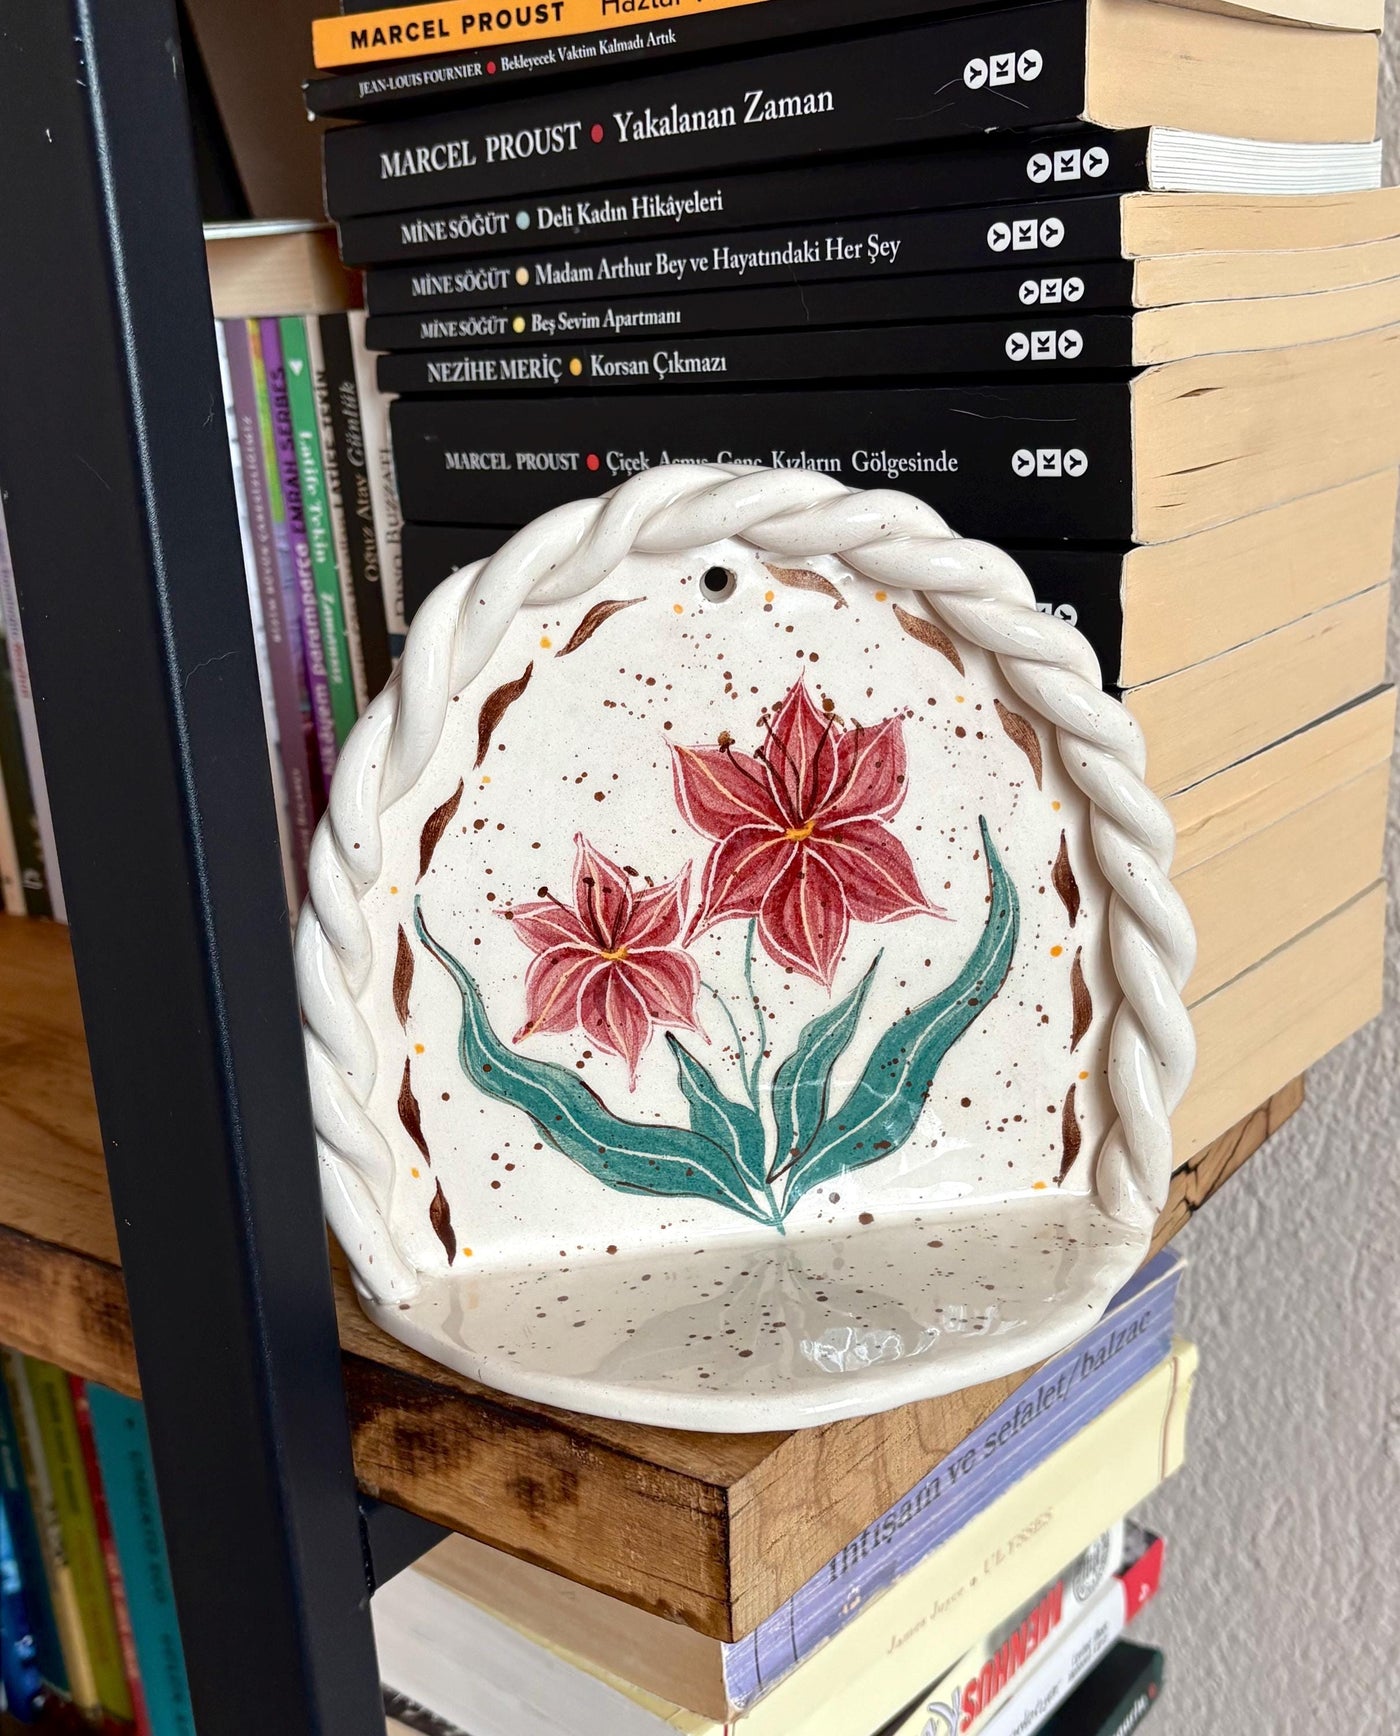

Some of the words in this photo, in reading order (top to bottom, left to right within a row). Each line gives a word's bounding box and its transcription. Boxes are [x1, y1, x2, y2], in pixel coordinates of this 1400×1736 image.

[351, 19, 450, 49] MARCEL
[462, 2, 565, 34] PROUST
[359, 72, 423, 98] JEAN-LOUIS
[424, 62, 482, 85] FOURNIER
[501, 51, 557, 73] Bekleyecek
[558, 44, 597, 62] Vaktim
[599, 34, 644, 55] Kalmadı
[646, 29, 677, 47] Artık
[380, 140, 476, 180] MARCEL
[486, 121, 582, 163] PROUST
[613, 103, 736, 142] Yakalanan
[743, 89, 834, 124] Zaman
[401, 217, 448, 244] MİNE
[449, 210, 510, 238] SÖĞÜT
[536, 204, 574, 230] Deli
[577, 200, 628, 225] Kadın
[631, 189, 723, 222] Hikâyeleri
[412, 270, 453, 296] MİNE
[454, 266, 511, 292] SÖĞÜT
[535, 260, 593, 286] Madam
[597, 256, 652, 280] Arthur
[655, 252, 687, 280] Bey
[690, 255, 709, 272] ve
[712, 241, 820, 276] Hayatındaki
[825, 236, 863, 261] Her
[867, 233, 901, 263] Şey
[421, 319, 457, 340] MİNE
[458, 313, 508, 338] SÖĞÜT
[531, 313, 556, 335] Beş
[558, 312, 600, 331] Sevim
[603, 308, 682, 332] Apartmanı
[427, 357, 498, 383] NEZİHE
[500, 353, 563, 384] MERİÇ
[590, 354, 649, 377] Korsan
[653, 351, 727, 380] Çıkmazı
[270, 366, 293, 453] SERBES
[337, 380, 366, 468] Günlük
[297, 431, 320, 496] Latife
[445, 452, 511, 471] MARCEL
[517, 452, 580, 471] PROUST
[606, 450, 650, 476] Çiçek
[771, 450, 842, 472] Kızların
[851, 450, 959, 479] Gölgesinde
[284, 458, 306, 535] EMRAH
[307, 501, 327, 563] Tekin
